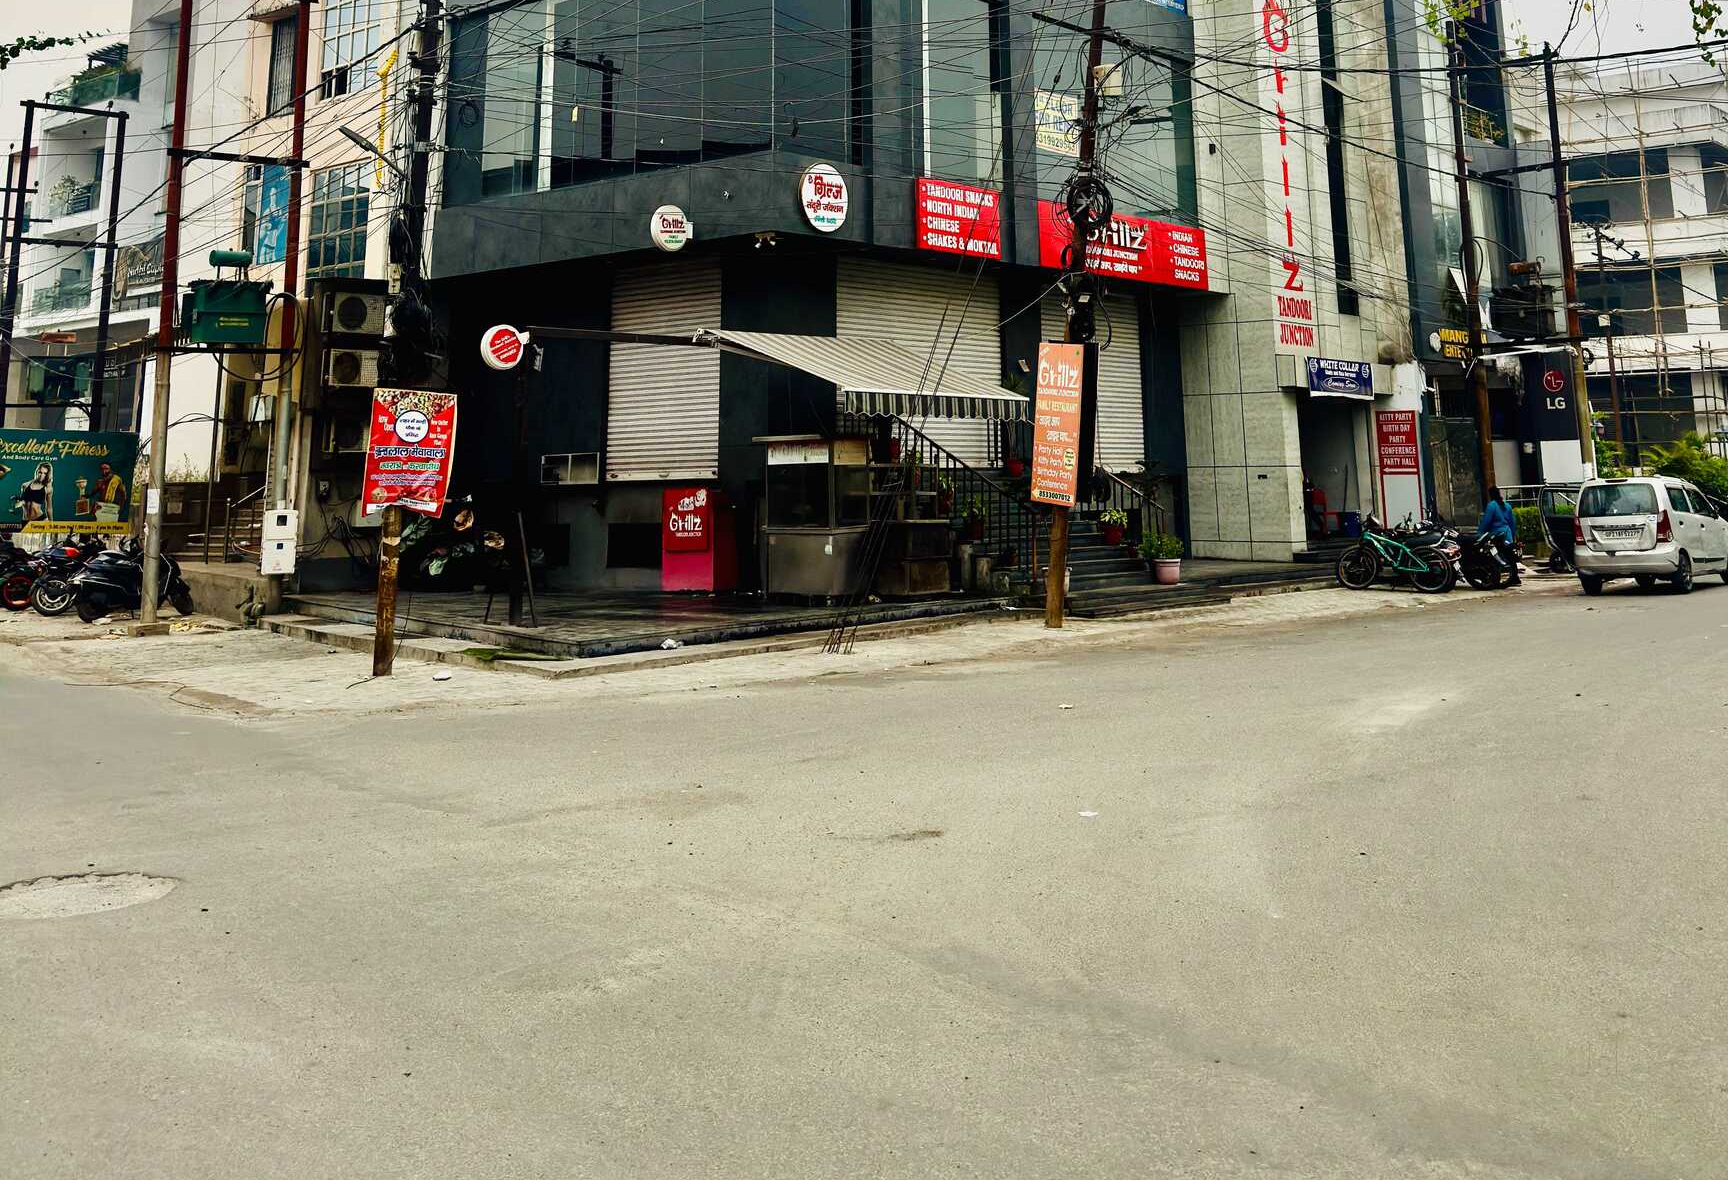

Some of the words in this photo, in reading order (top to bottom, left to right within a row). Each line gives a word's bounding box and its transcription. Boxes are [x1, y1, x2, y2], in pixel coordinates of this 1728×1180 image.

[926, 183, 964, 202] TANDOORI
[965, 191, 994, 207] SNACKS
[926, 200, 952, 216] NORTH
[954, 204, 980, 220] INDIAN
[927, 216, 960, 233] CHINESE
[927, 232, 957, 249] SHAKES
[958, 237, 965, 250] &
[1173, 244, 1200, 257] CHINESE
[1174, 257, 1205, 270] TANDOORI
[1175, 269, 1200, 281] SNACKS
[1277, 295, 1312, 321] TANDOORI
[1280, 323, 1314, 347] JUNCTION
[1320, 359, 1338, 370] WHITE
[1339, 361, 1359, 372] COLLAR
[1546, 397, 1566, 410] LG
[1395, 413, 1412, 421] PARTY
[1389, 435, 1406, 443] PARTY
[59, 439, 110, 458] Fitness
[1381, 446, 1416, 454] CONFERENCE
[1402, 458, 1416, 466] HALL
[669, 512, 703, 531] Grillz
